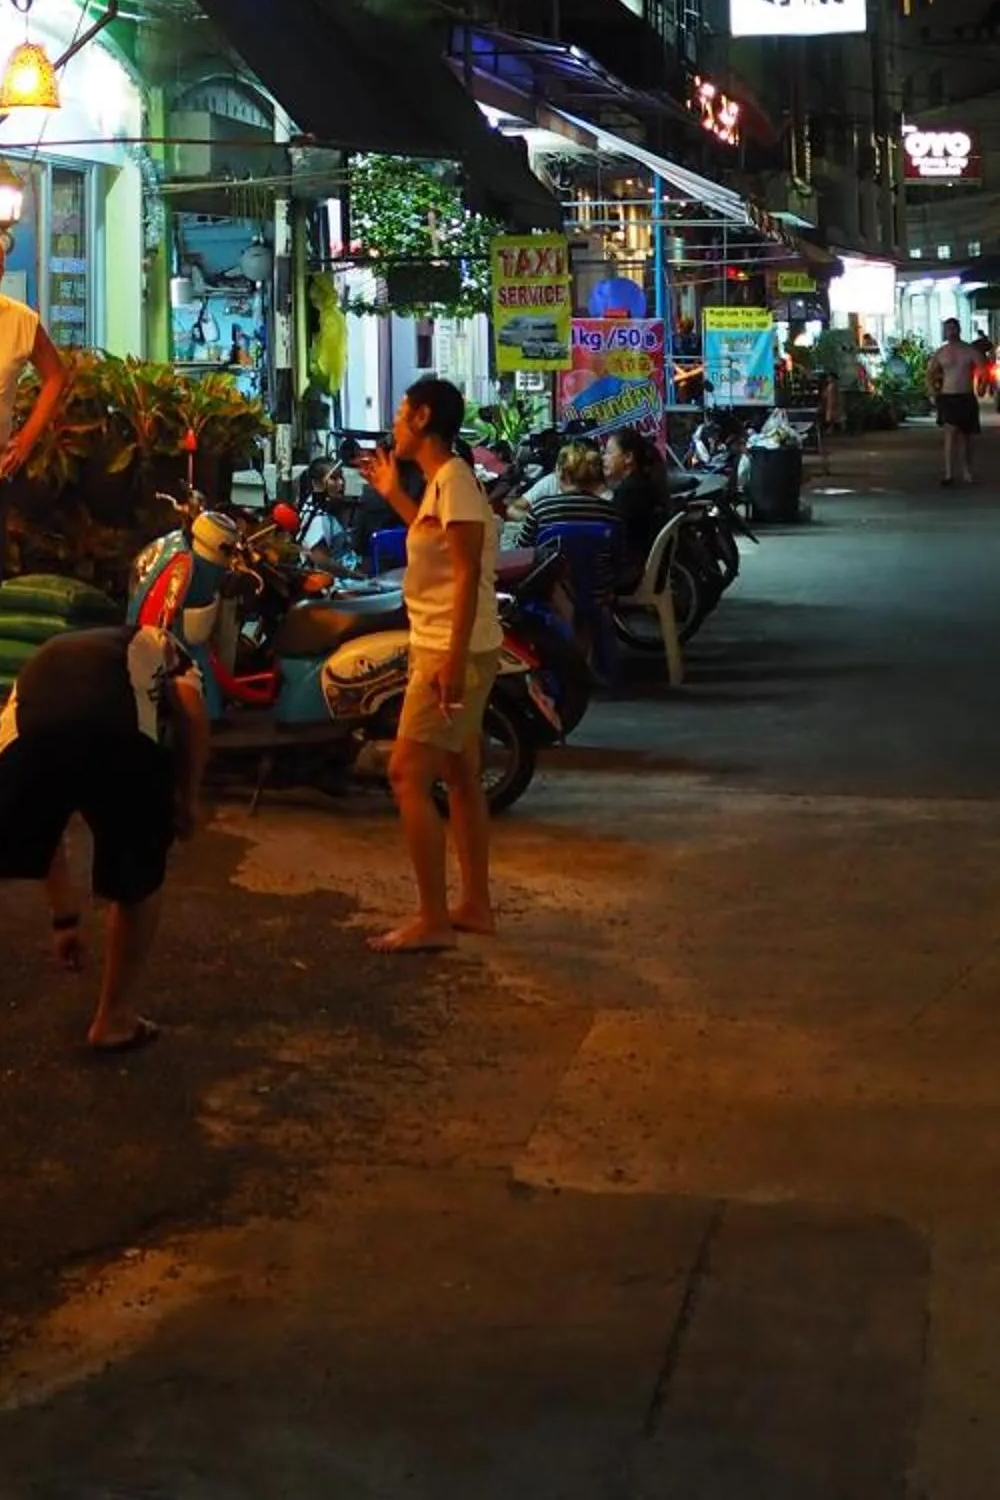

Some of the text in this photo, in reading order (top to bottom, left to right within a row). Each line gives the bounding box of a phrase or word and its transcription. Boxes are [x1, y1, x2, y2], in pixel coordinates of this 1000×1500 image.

[905, 131, 971, 157] OYO
[498, 247, 565, 277] TAXI
[498, 284, 566, 307] SERVICE
